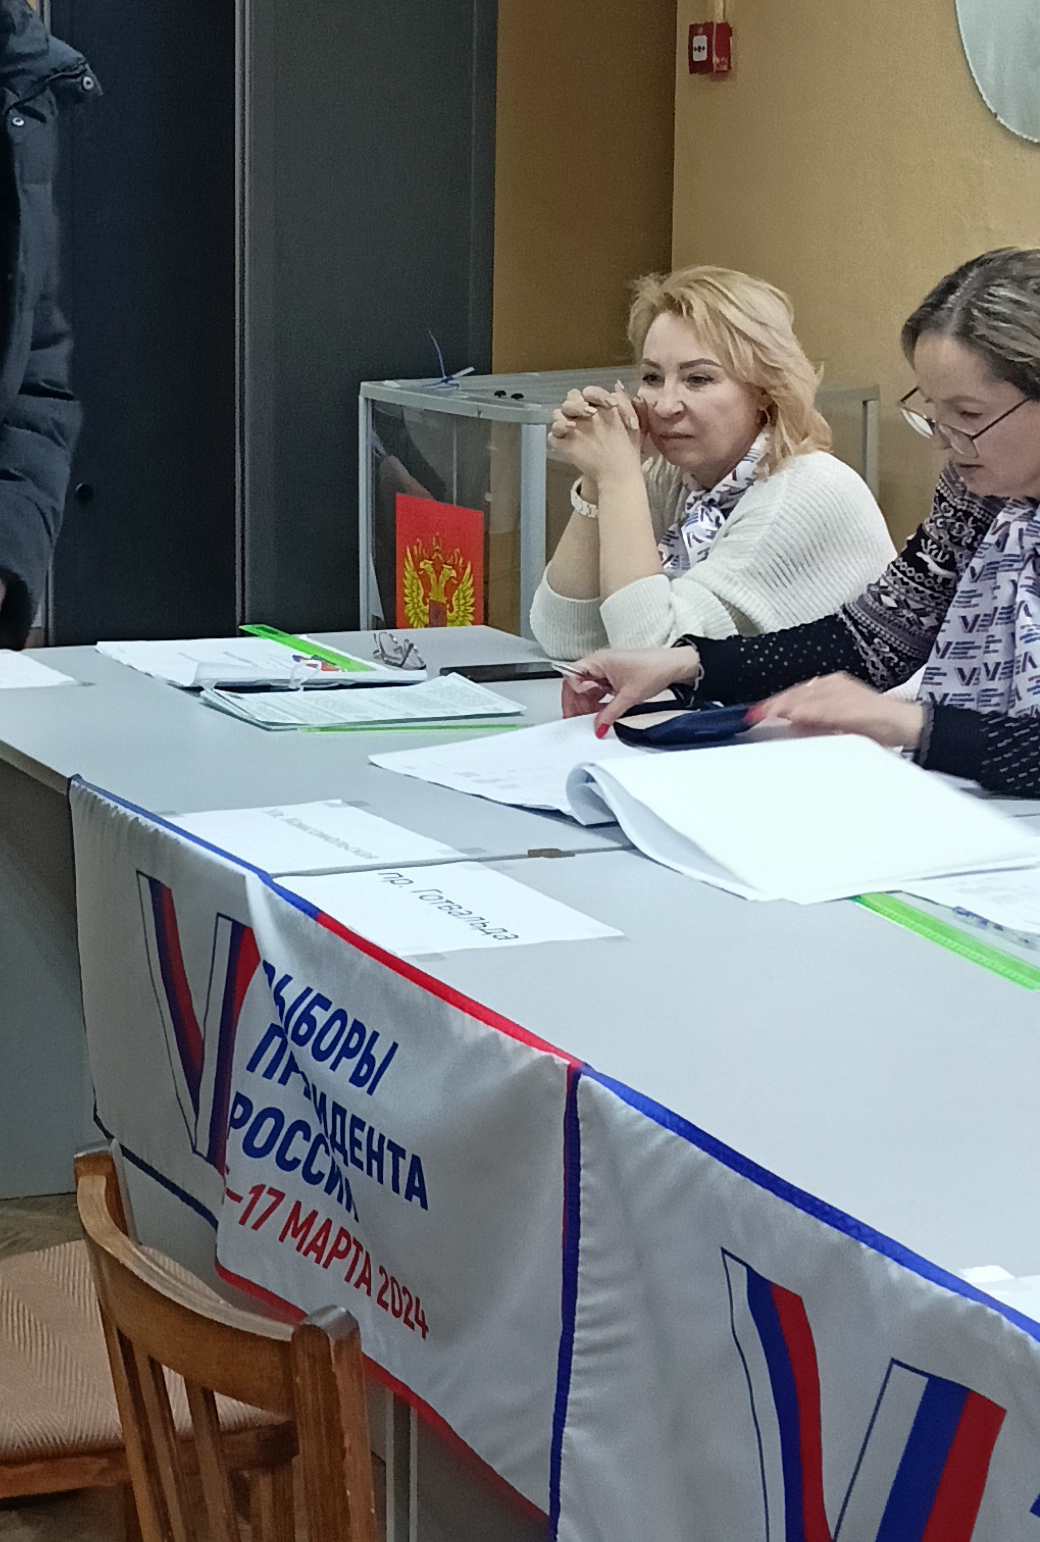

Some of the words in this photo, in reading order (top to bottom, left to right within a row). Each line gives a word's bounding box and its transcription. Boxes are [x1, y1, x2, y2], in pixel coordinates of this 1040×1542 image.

[378, 872, 414, 888] пр.
[411, 888, 520, 941] Готвальда
[278, 1200, 372, 1297] МАРТА
[376, 1264, 429, 1340] 2024
